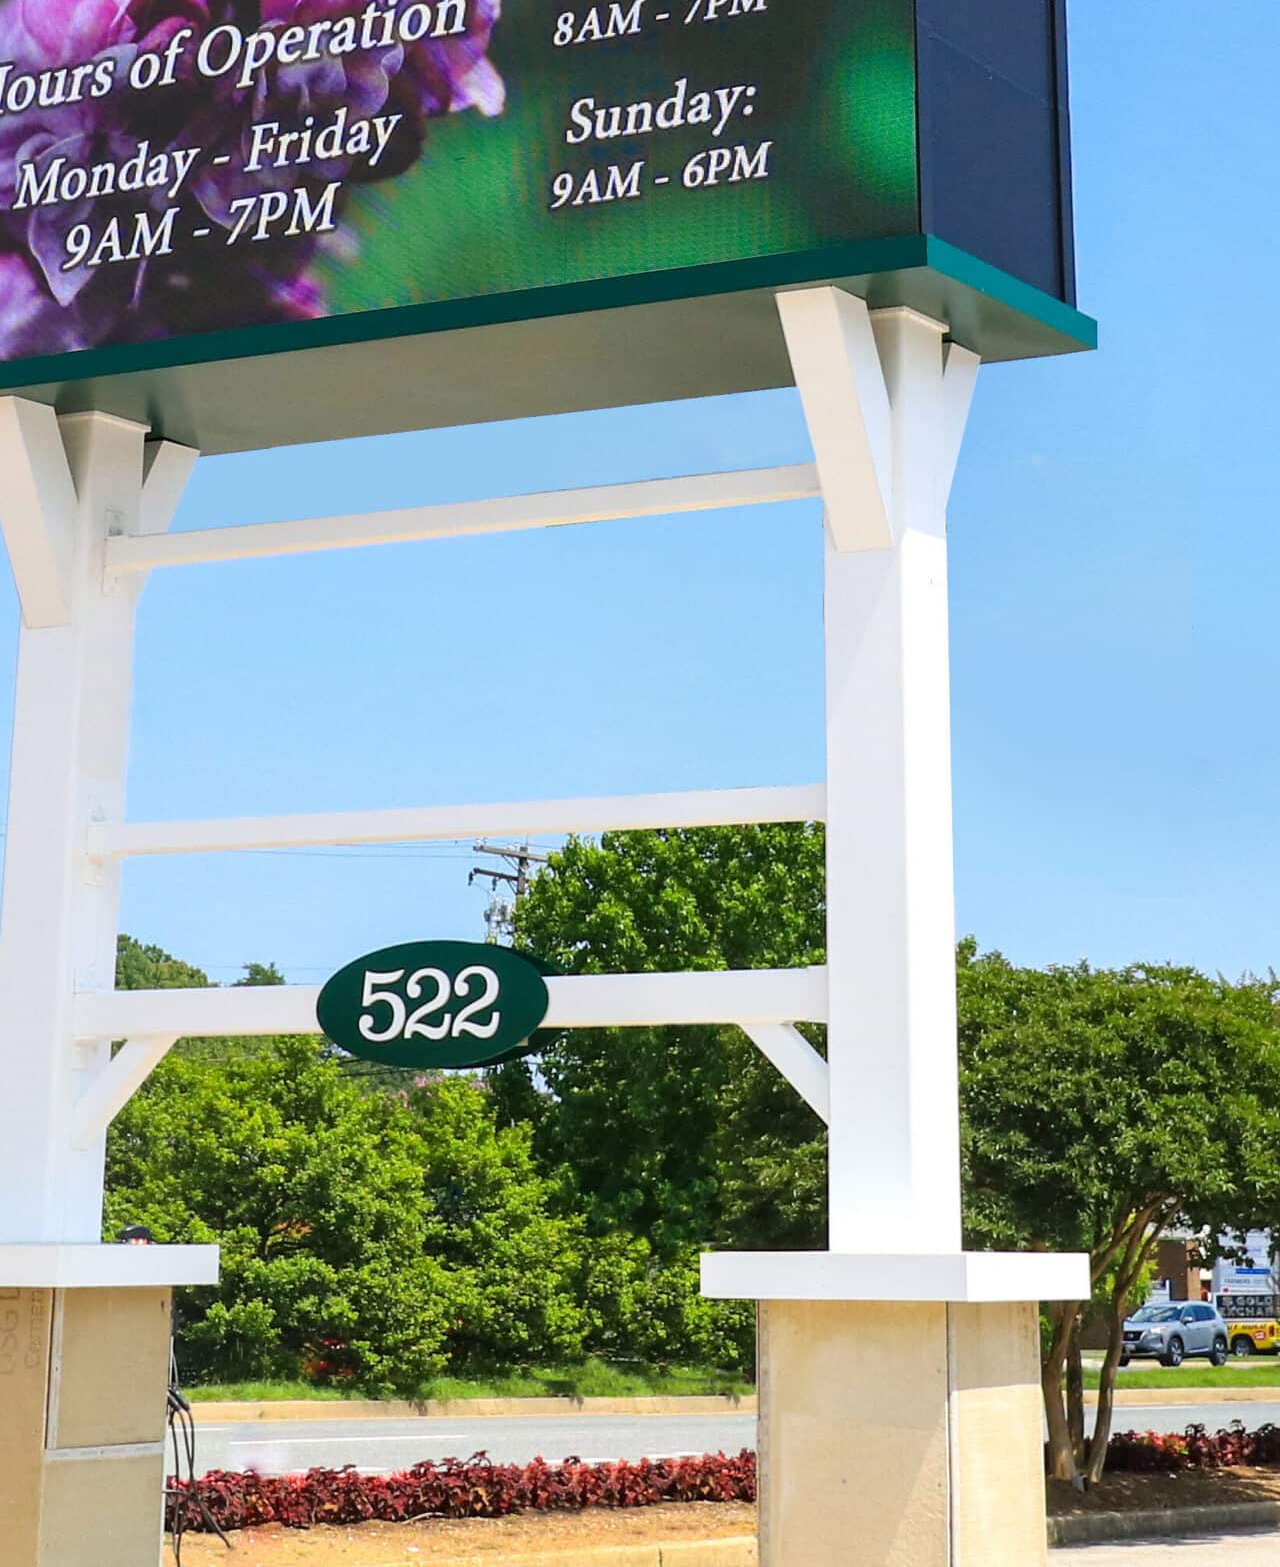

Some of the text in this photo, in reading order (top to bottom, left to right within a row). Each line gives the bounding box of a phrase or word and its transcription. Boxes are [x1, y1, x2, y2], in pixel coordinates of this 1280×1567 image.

[130, 27, 197, 90] of
[566, 77, 757, 144] Sunday:
[11, 140, 201, 210] Monday
[243, 107, 403, 173] Friday
[550, 161, 645, 209] 9AM
[682, 141, 773, 189] 6PM
[60, 206, 181, 271] 9AM
[226, 181, 342, 246] 7PM
[358, 964, 501, 1042] 522
